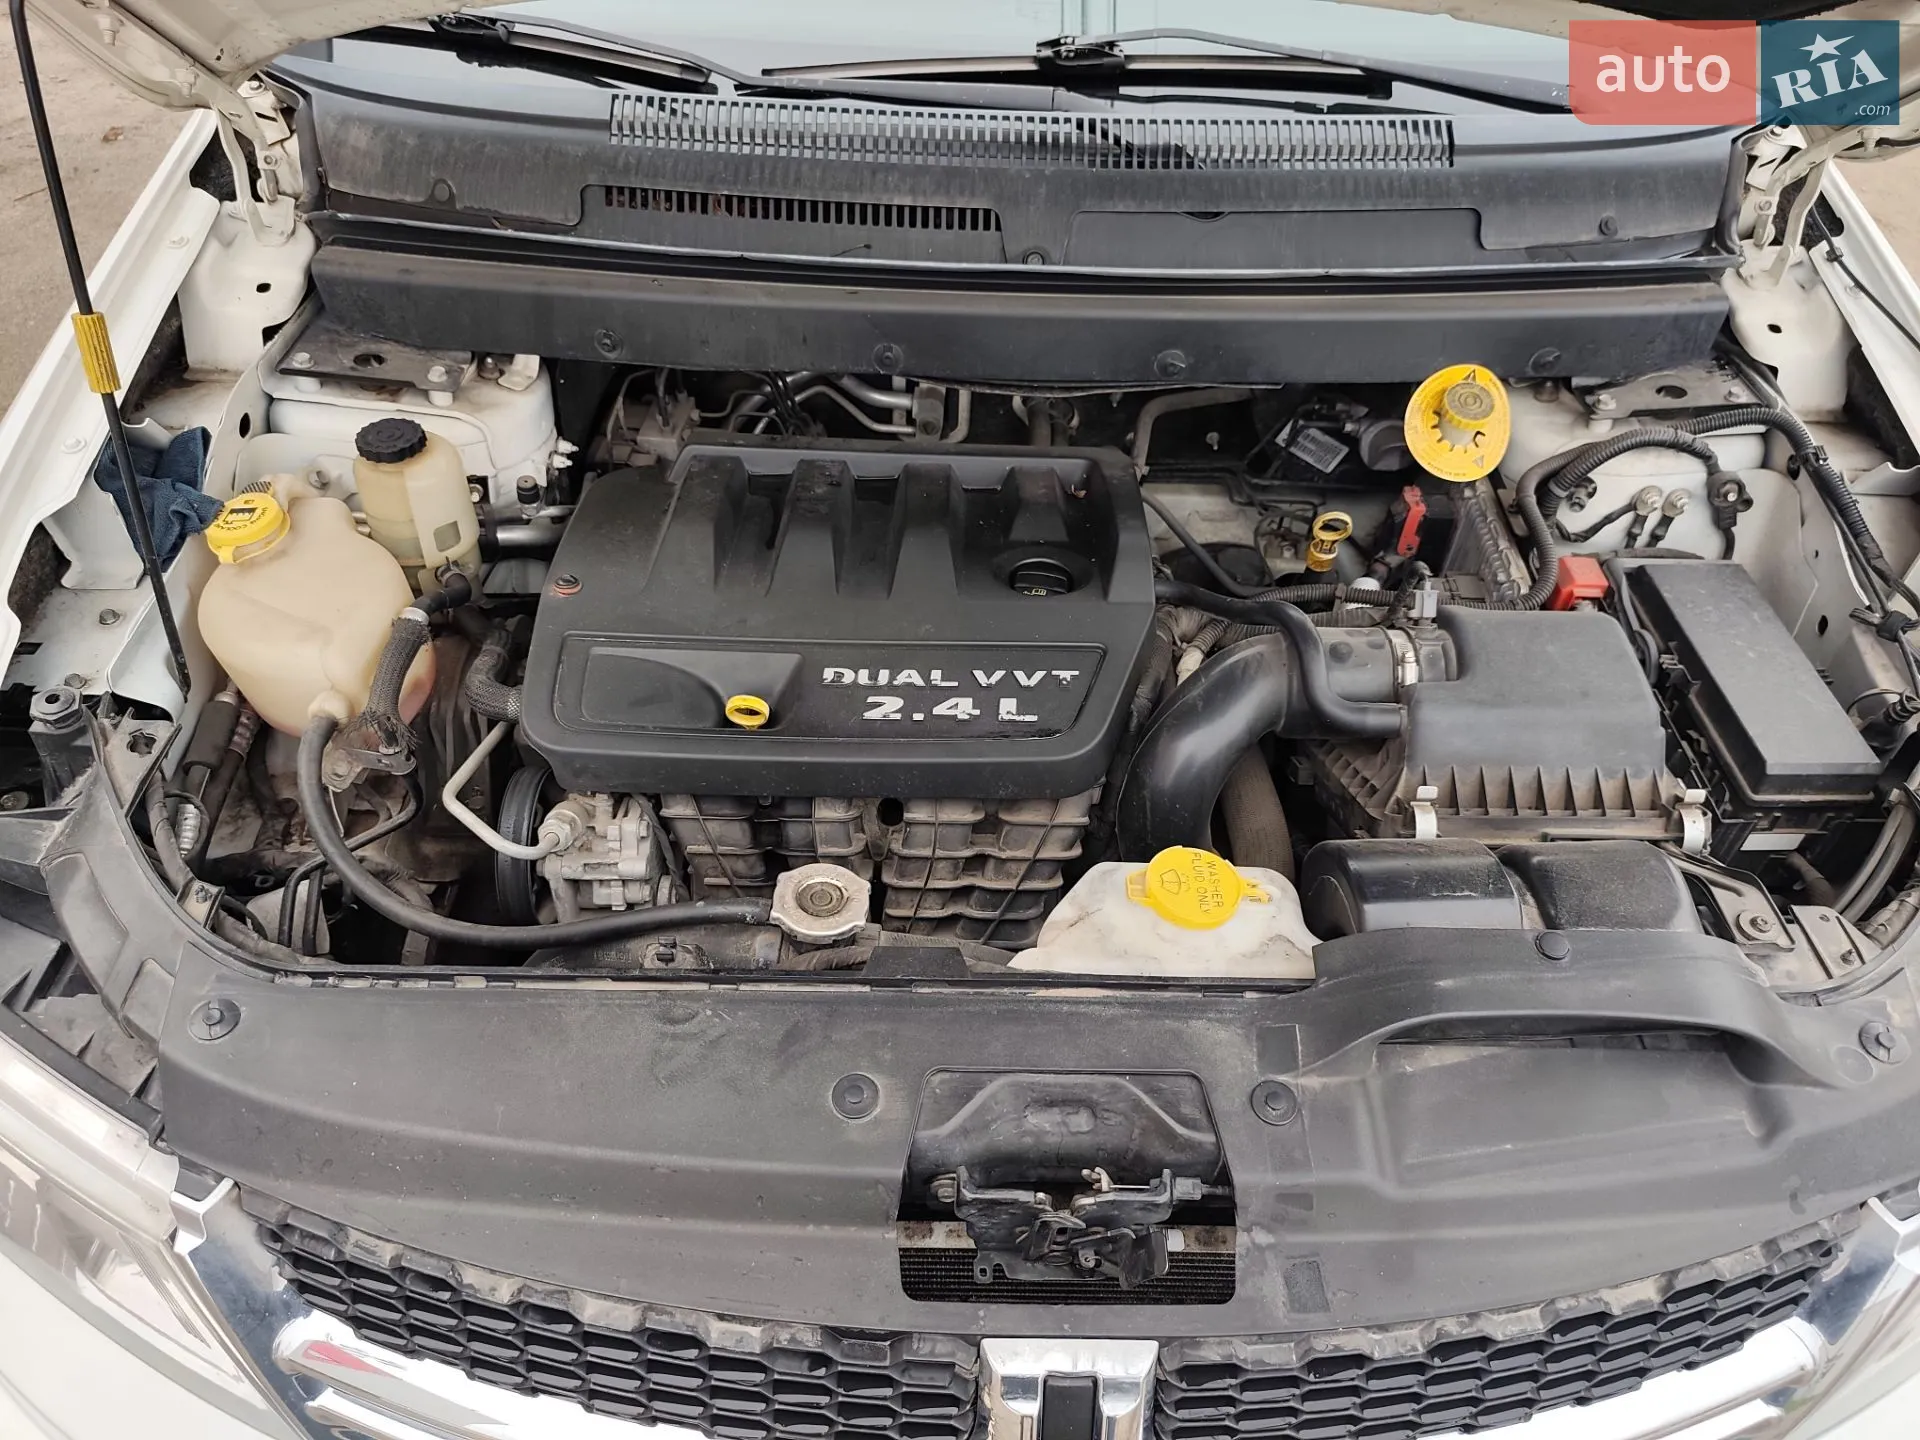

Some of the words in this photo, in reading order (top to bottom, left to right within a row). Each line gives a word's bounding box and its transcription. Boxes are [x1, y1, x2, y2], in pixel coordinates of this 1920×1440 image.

[822, 667, 959, 687] DUAL
[971, 669, 1080, 688] VVT
[1192, 852, 1206, 882] FLUID
[1206, 860, 1224, 908] WASHER
[1196, 887, 1211, 914] ONLY
